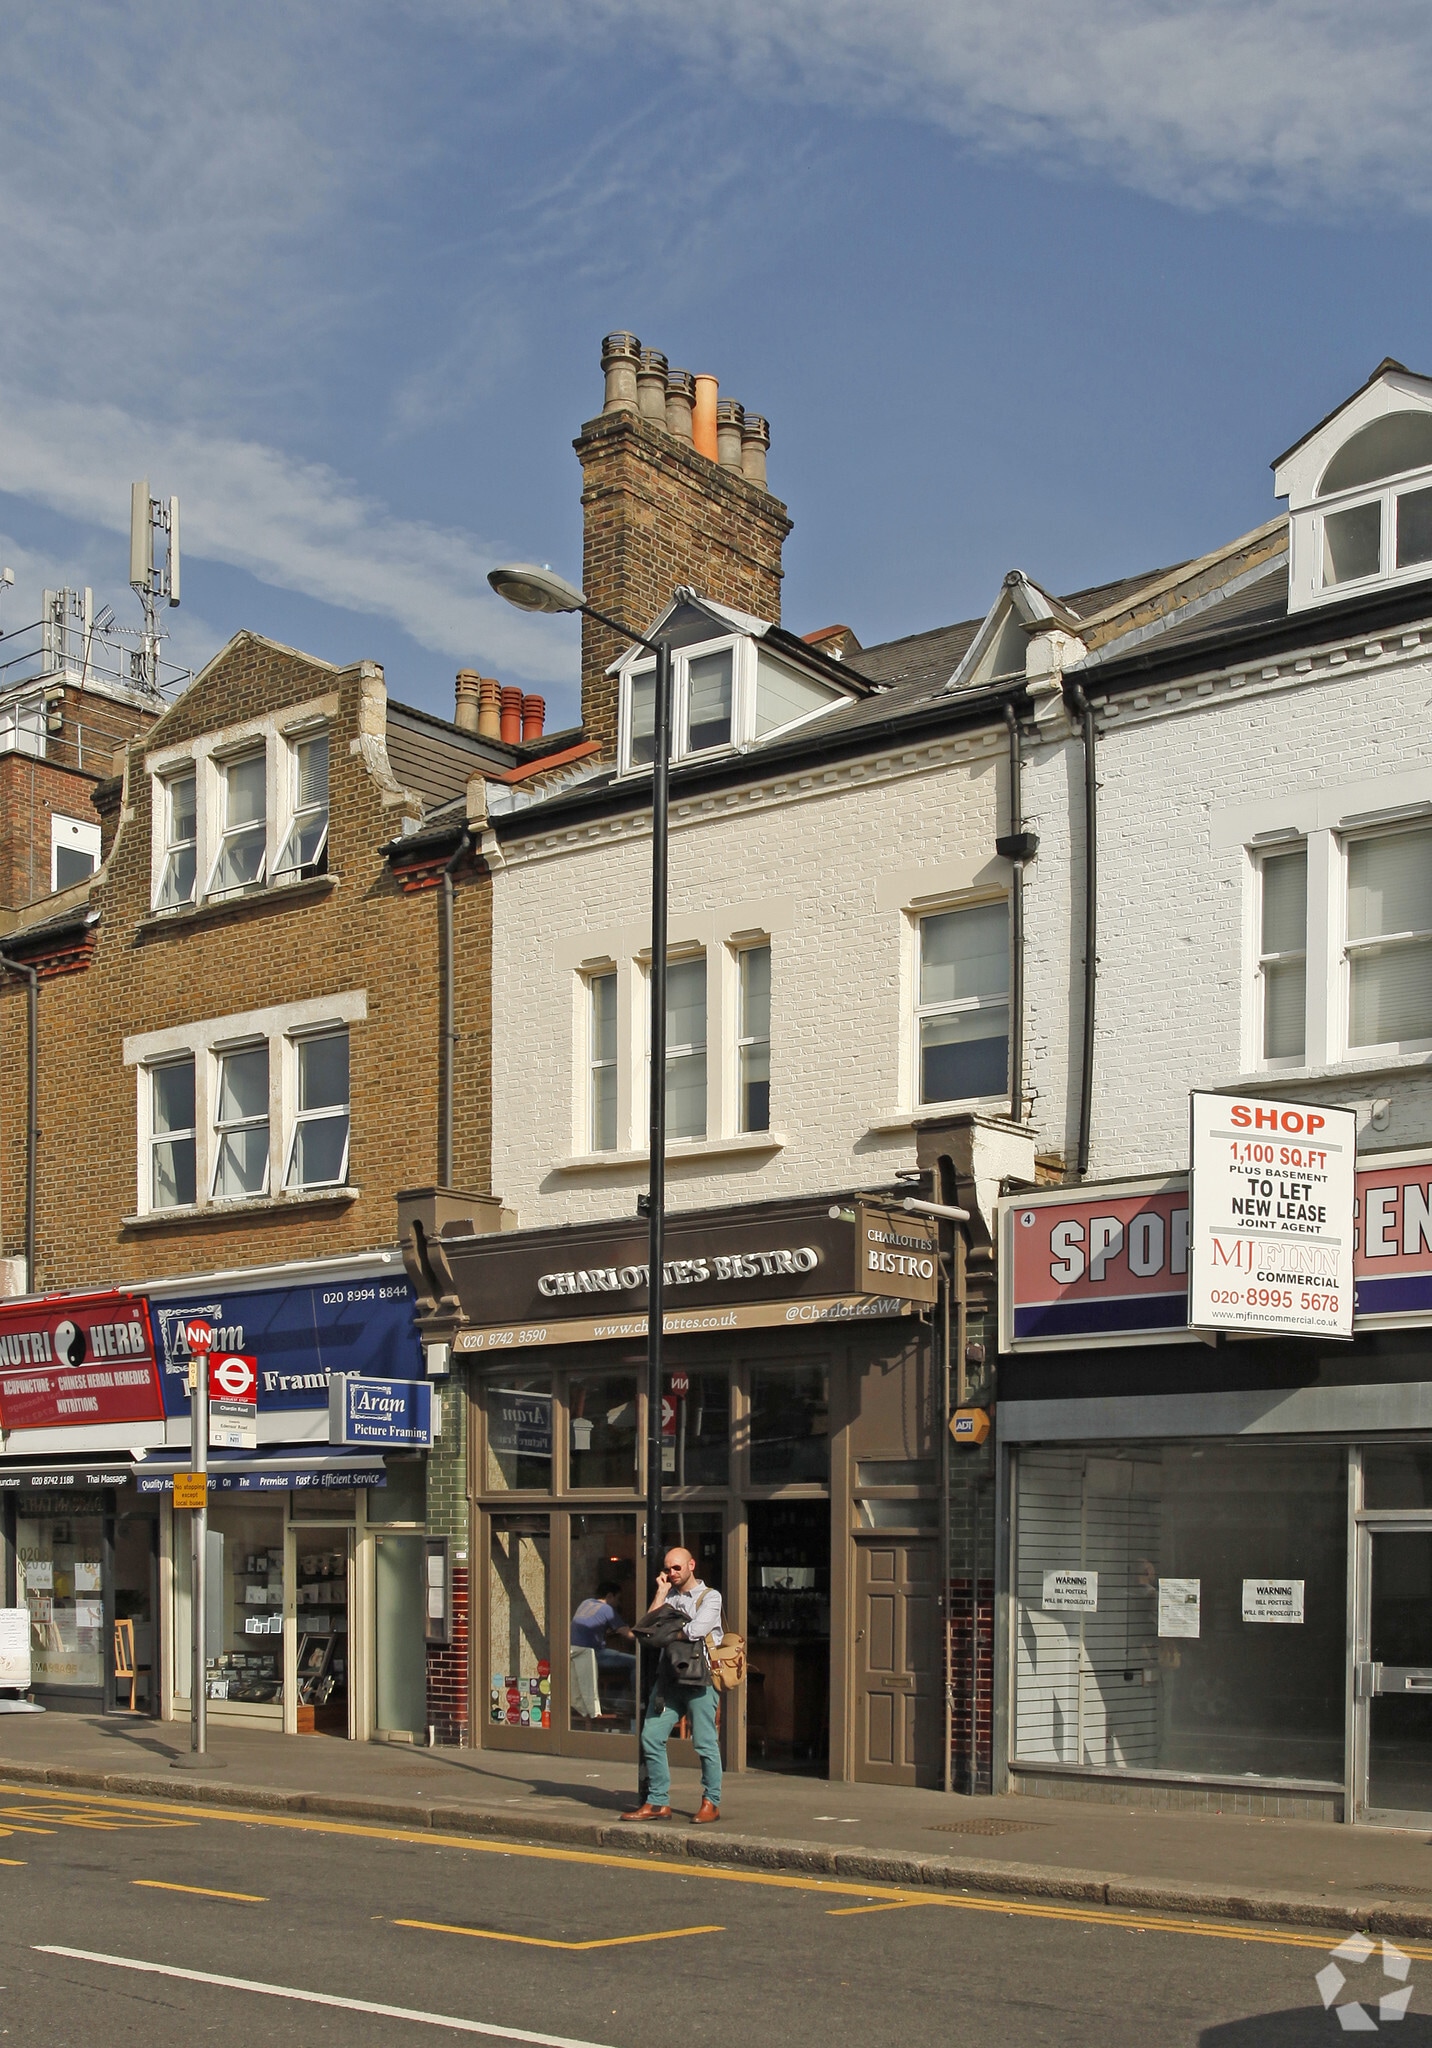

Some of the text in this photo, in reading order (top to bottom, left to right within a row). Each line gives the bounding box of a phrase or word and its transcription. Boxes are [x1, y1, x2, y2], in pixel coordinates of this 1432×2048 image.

[1230, 1105, 1325, 1135] SHOP
[1230, 1142, 1327, 1170] 1,100 SQ.FT
[1230, 1166, 1328, 1182] PLUS BASEMENT
[1248, 1178, 1312, 1201] TO LET
[1024, 1214, 1031, 1224] 4
[1232, 1198, 1326, 1223] NEW LEASE
[1237, 1218, 1322, 1234] JOINT AGENT
[867, 1230, 933, 1250] CHARLOTTE'S
[713, 1248, 818, 1281] BISTRO
[868, 1250, 933, 1279] BISTRO
[1257, 1272, 1339, 1288] COMMERCIAL
[323, 1285, 408, 1304] 020 8994 8844
[1300, 1293, 1339, 1312] 5678
[785, 1299, 900, 1320] @CharlottesW4
[1212, 1311, 1338, 1327] www.mjfinncommercial.co.uk
[594, 1312, 737, 1336] www.chlottes.co.uk
[0, 1322, 145, 1367] NUTRI HERB
[187, 1327, 212, 1343] NN
[463, 1328, 547, 1348] 020 8742 3590
[3, 1369, 150, 1395] ACUPUNCTURE CHINESE HERBAL REMEDIES
[56, 1396, 99, 1413] NUTRITIONS
[358, 1392, 405, 1412] Aram
[354, 1424, 427, 1441] Picture Framing
[956, 1421, 973, 1430] ADT
[32, 1476, 43, 1485] 020
[44, 1476, 59, 1485] 8742
[60, 1475, 74, 1484] 1188
[86, 1474, 100, 1484] Thai
[100, 1474, 127, 1484] Massage
[141, 1480, 164, 1491] Quality
[222, 1478, 231, 1487] On
[239, 1477, 250, 1486] The
[260, 1476, 288, 1486] Premises
[295, 1474, 310, 1485] Fast
[312, 1476, 319, 1484] &
[321, 1473, 351, 1486] Efficient
[353, 1473, 380, 1484] Service
[1056, 1577, 1086, 1585] WARNING
[1256, 1587, 1292, 1595] WARNING
